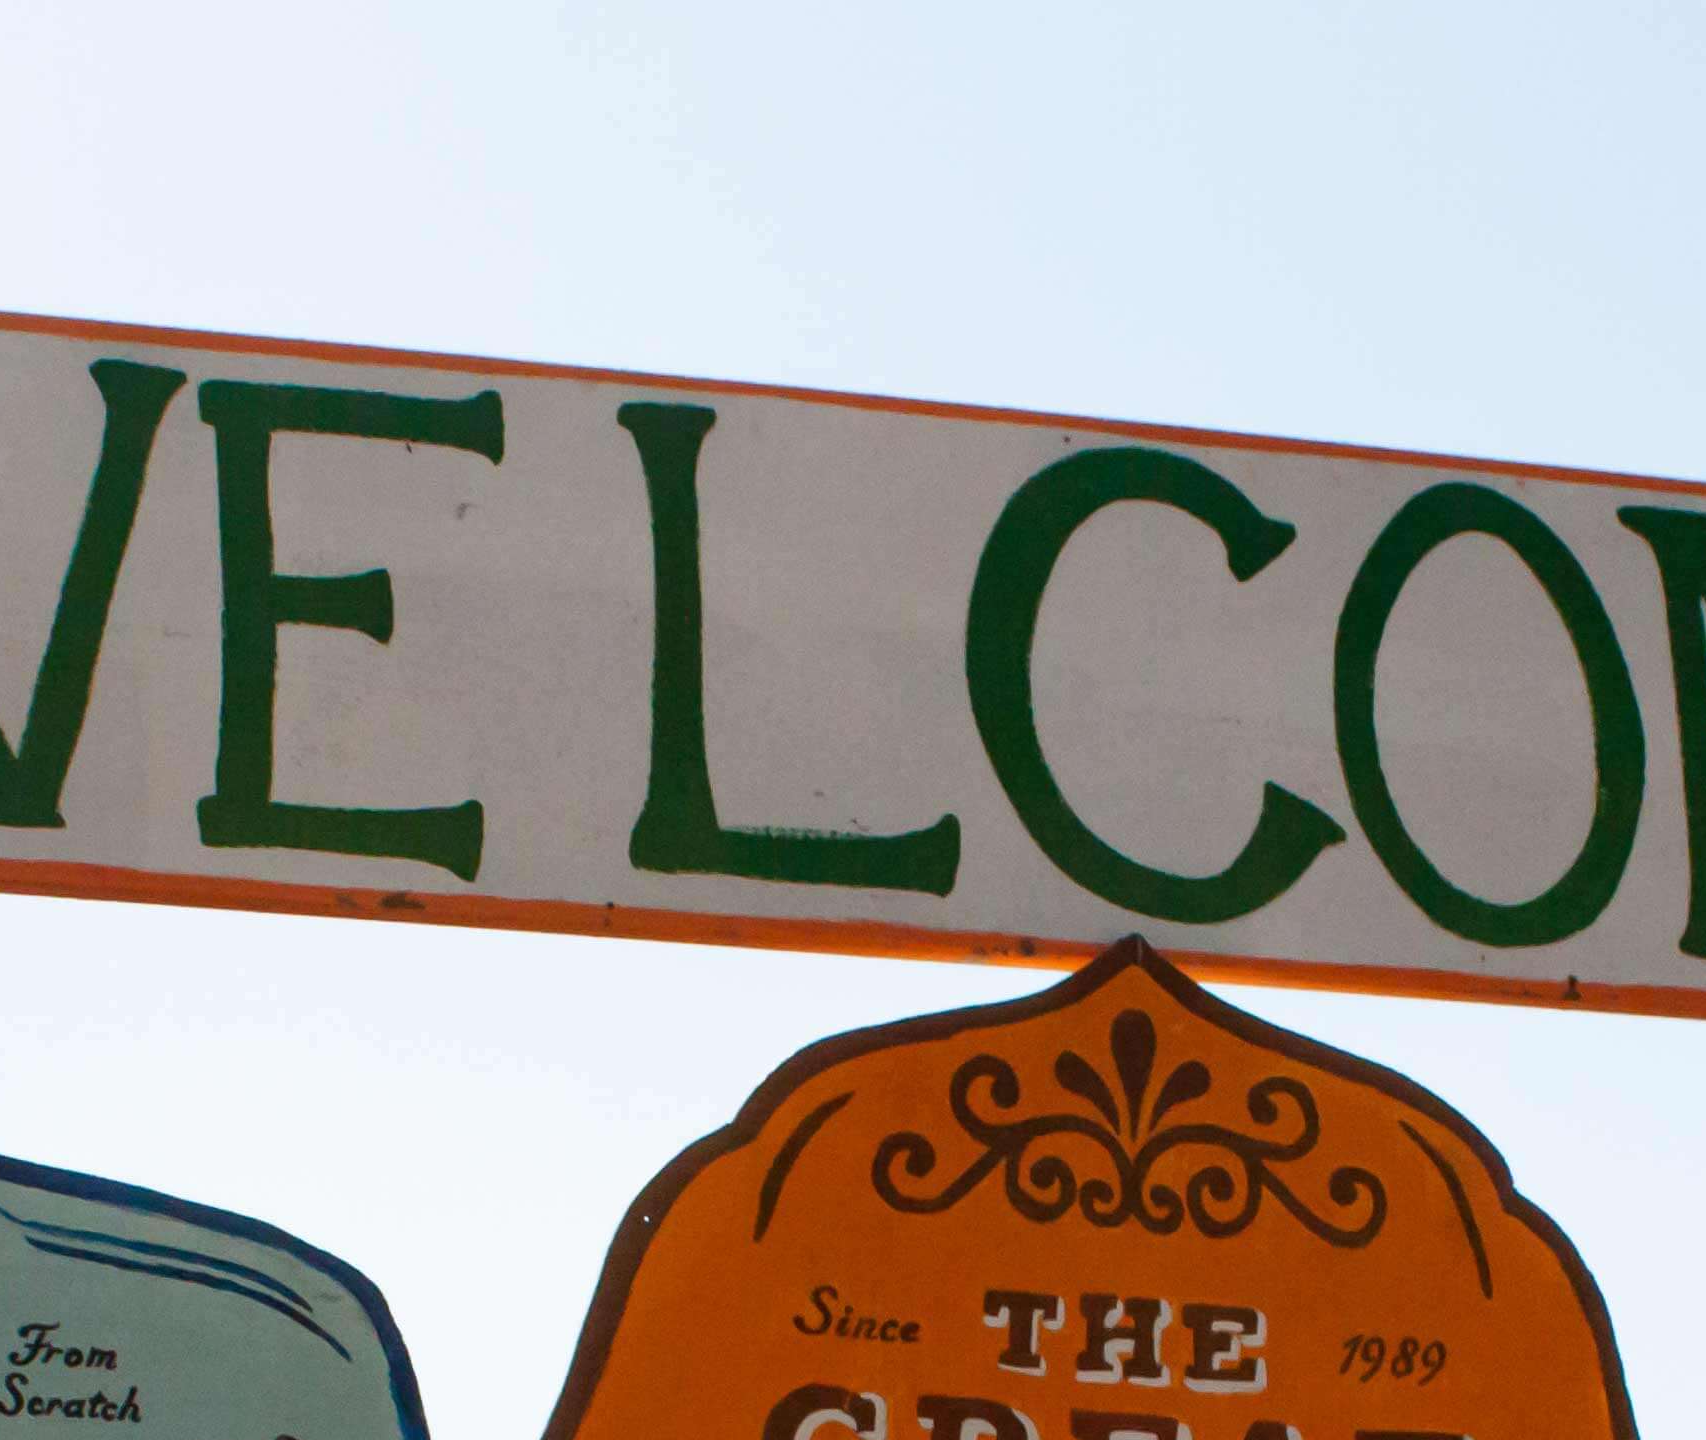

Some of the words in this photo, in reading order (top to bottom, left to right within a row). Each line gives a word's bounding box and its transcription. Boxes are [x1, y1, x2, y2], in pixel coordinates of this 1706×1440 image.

[793, 1285, 921, 1344] Since
[983, 1289, 1267, 1391] THE
[9, 1322, 119, 1372] From
[1340, 1334, 1447, 1386] 1989
